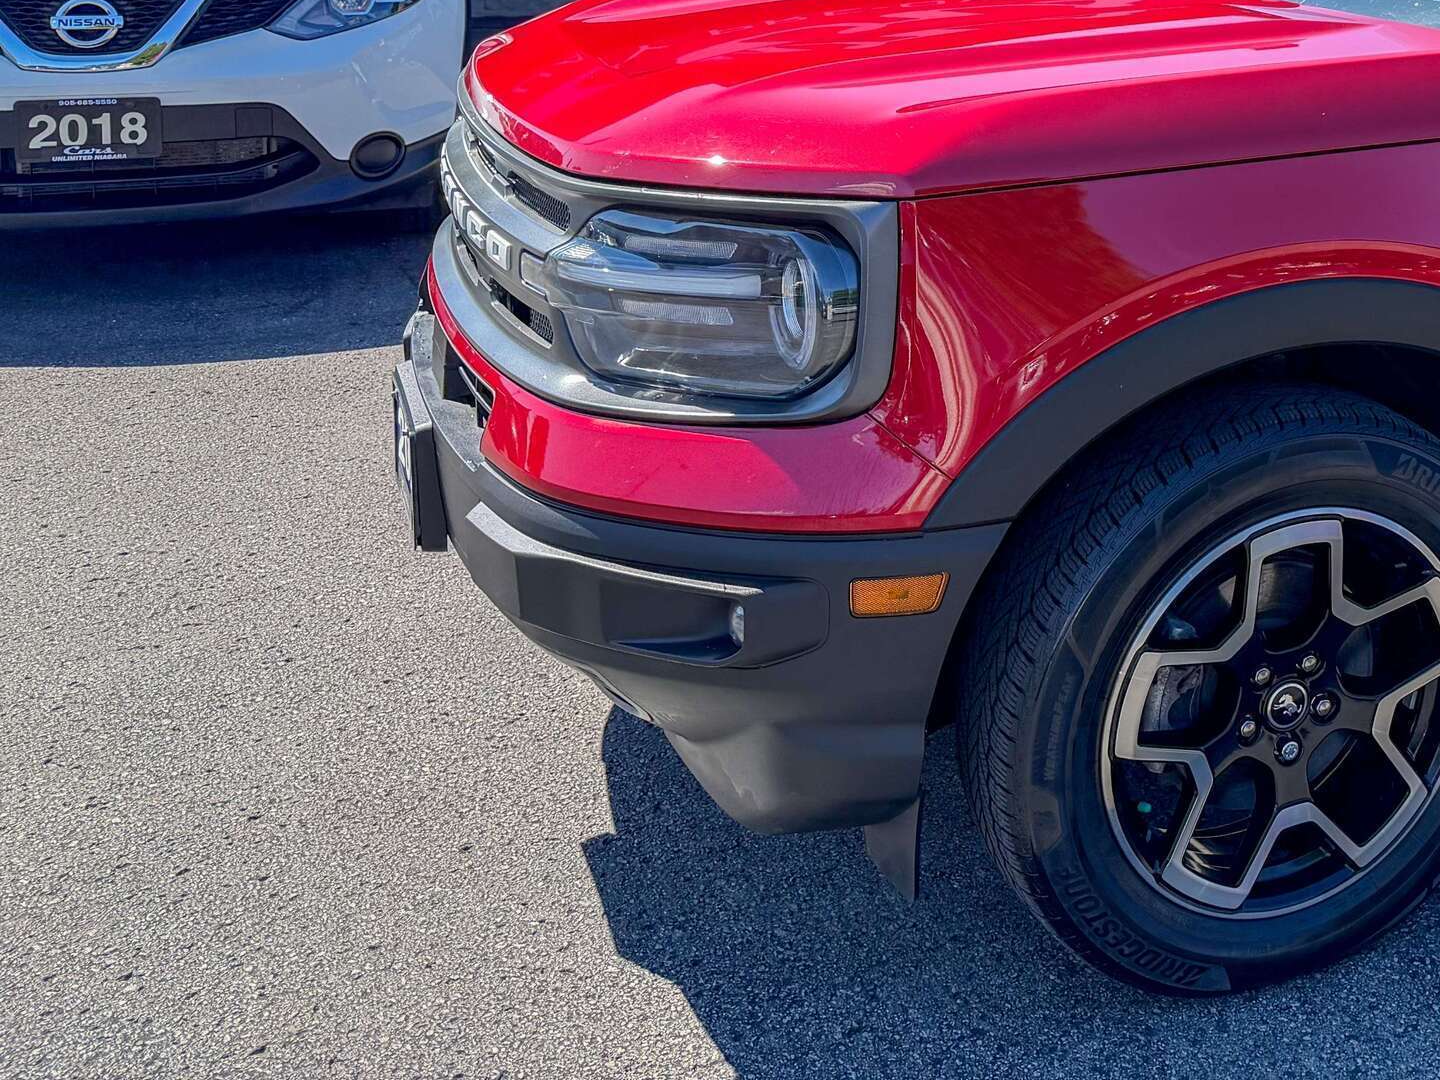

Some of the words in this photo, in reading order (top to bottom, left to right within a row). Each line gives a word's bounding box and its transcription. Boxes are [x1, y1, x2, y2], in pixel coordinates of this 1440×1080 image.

[58, 18, 115, 27] NISSAN
[28, 111, 148, 150] 2018
[52, 155, 93, 163] UNLIMITED
